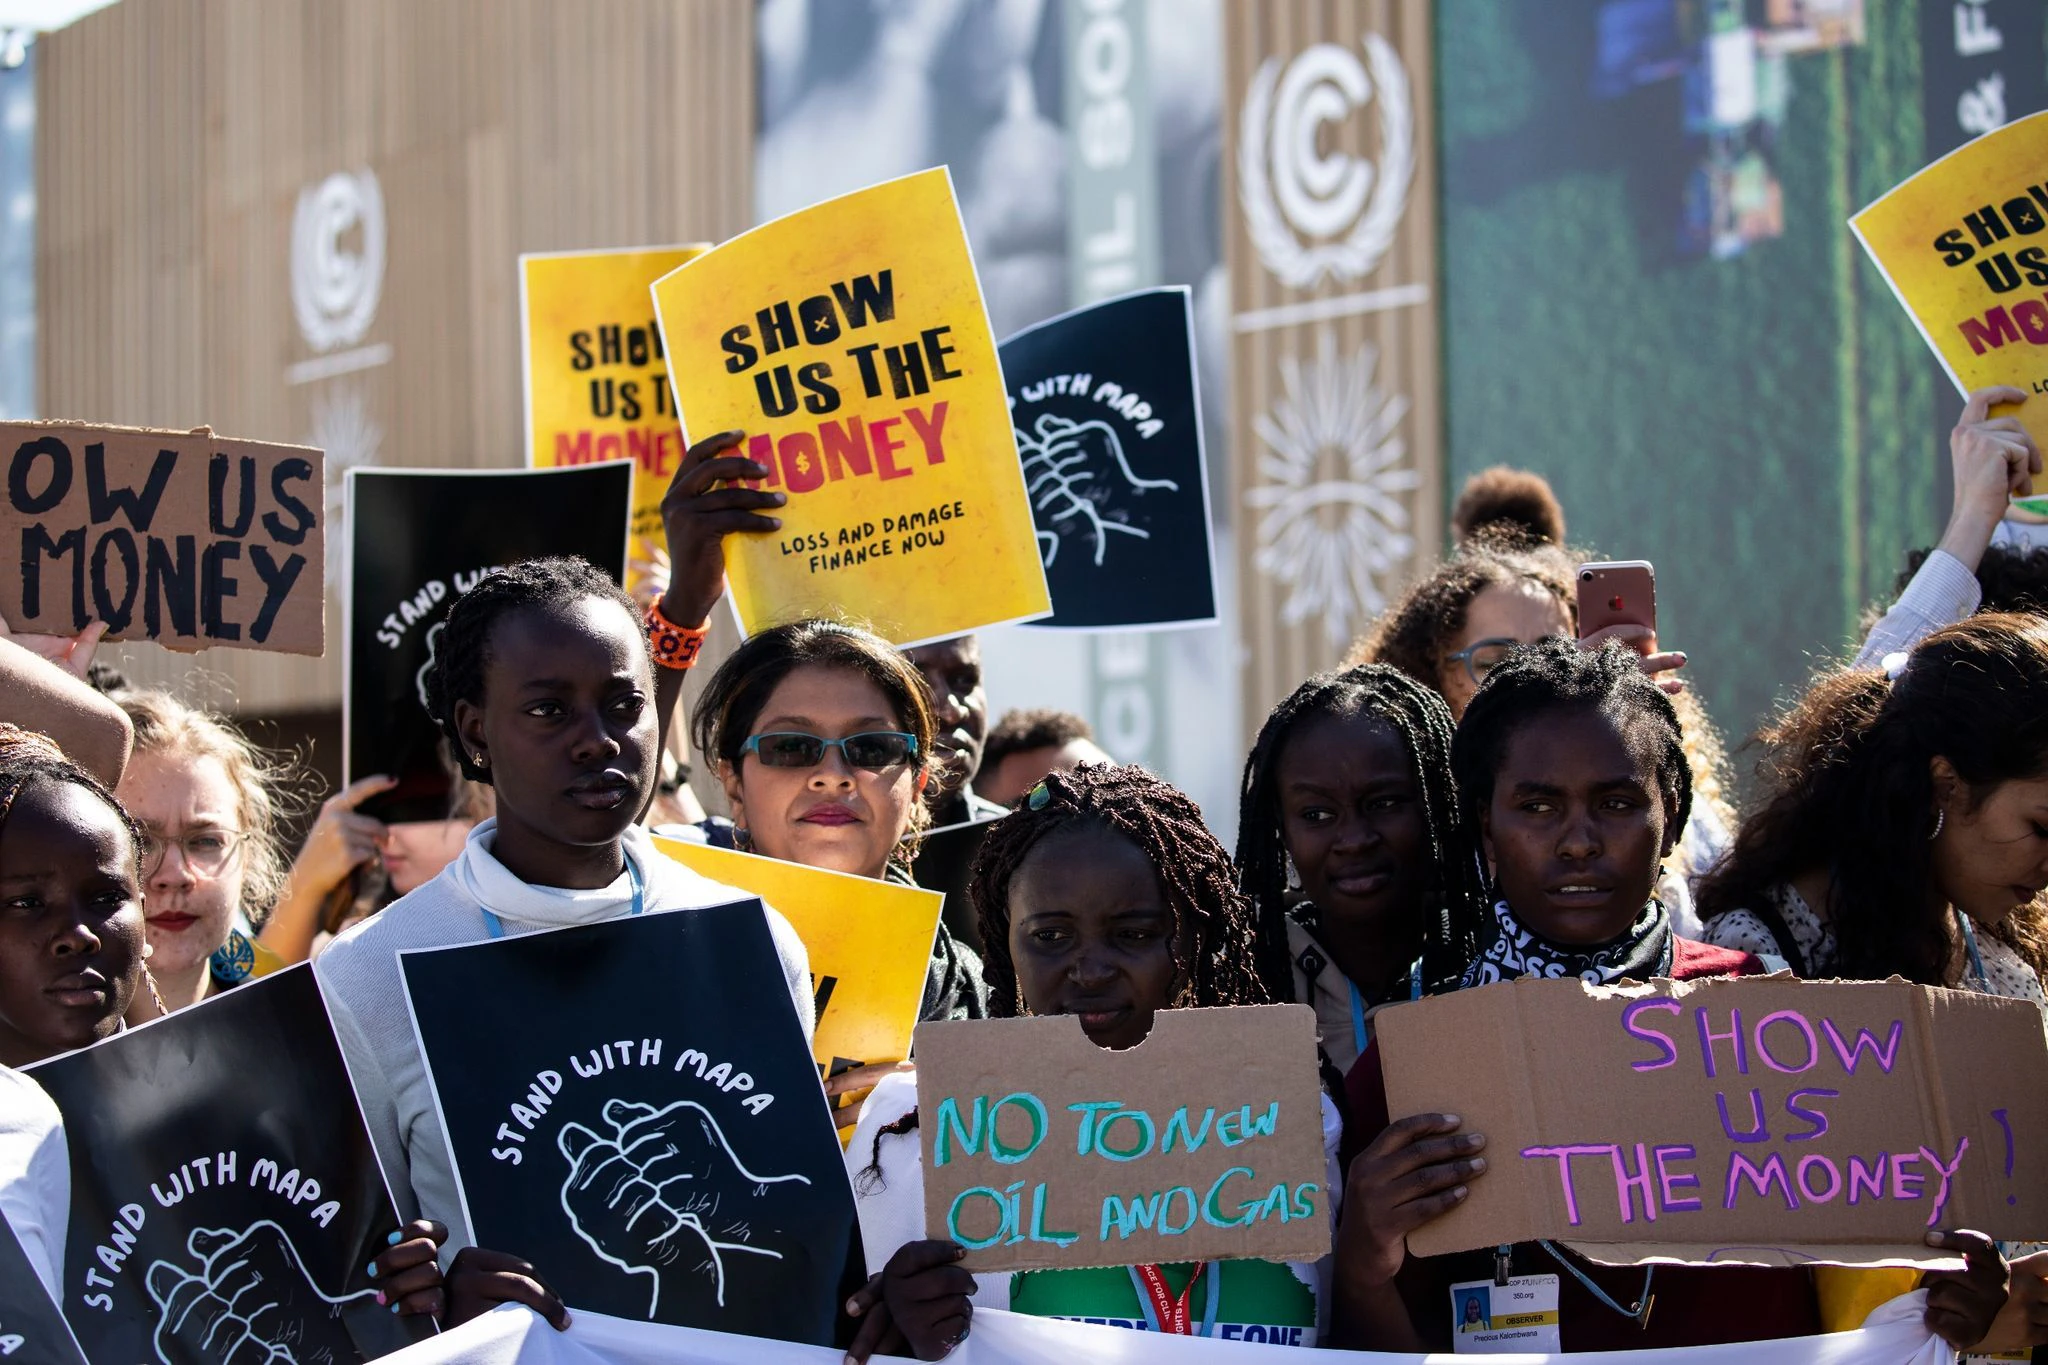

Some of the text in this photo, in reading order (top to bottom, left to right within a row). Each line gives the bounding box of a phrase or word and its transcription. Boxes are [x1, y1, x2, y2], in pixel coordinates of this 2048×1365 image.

[1975, 246, 2048, 294] US
[720, 268, 896, 374] SHOW
[1958, 292, 2048, 356] MO
[590, 377, 642, 421] US
[754, 325, 962, 418] US THE
[1021, 373, 1165, 439] WITH MAPA
[719, 401, 949, 494] MONEY
[8, 436, 316, 546] OW US
[781, 501, 965, 555] LOSS AND DAMAGE
[809, 530, 945, 573] FINANCE NOW
[21, 523, 306, 643] MONEY
[376, 579, 447, 649] STAND
[1621, 997, 1903, 1078] SHOW
[491, 1070, 563, 1166] STAND
[569, 1038, 663, 1078] WITH
[674, 1049, 775, 1115] MAPA
[933, 1092, 1279, 1167] NO TO NEW
[1715, 1087, 1840, 1143] US
[947, 1166, 1319, 1250] OIL AND GAS
[1520, 1142, 1702, 1226] THE
[1722, 1136, 1969, 1228] MONEY
[83, 1150, 341, 1312] STAND WITH MAPA
[1144, 1263, 1158, 1282] ACE
[1153, 1282, 1166, 1300] FOR
[1513, 1292, 1535, 1300] 350.org
[1474, 1331, 1538, 1343] Precious Kalombwana
[1506, 1314, 1544, 1325] OBSERVER
